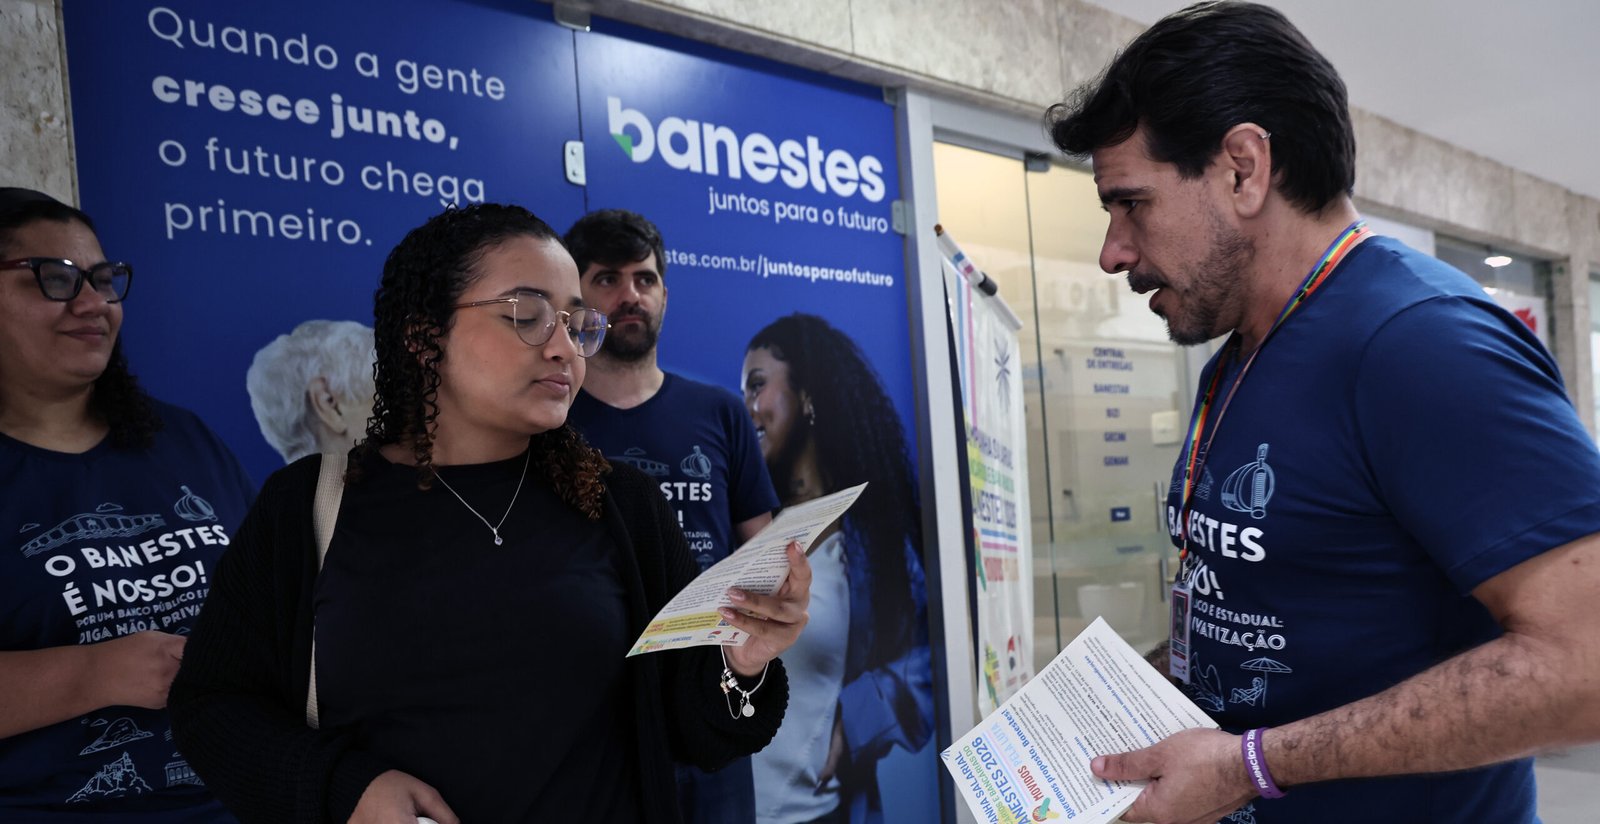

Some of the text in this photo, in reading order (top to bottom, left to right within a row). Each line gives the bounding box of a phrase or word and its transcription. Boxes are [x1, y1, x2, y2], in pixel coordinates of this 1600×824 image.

[148, 7, 505, 100] Quando a gente
[152, 75, 459, 150] cresce junto,
[159, 137, 485, 207] o futuro chega
[607, 96, 886, 202] banestes
[165, 199, 373, 245] primeiro.
[708, 186, 888, 233] juntos para o futuro
[664, 249, 894, 286] stes.com.br/juntosparaofuturo
[660, 482, 712, 502] STES
[45, 525, 230, 577] O BANESTES
[62, 561, 207, 616] É NOSSO!
[97, 611, 115, 622] UM
[117, 606, 151, 618] BANCO
[153, 591, 195, 613] PÚBLICO
[116, 619, 147, 635] NÃO
[962, 744, 973, 756] DO
[1000, 708, 1030, 747] Banestes!
[954, 751, 985, 798] SALARIAL
[968, 756, 997, 796] BANCÁRIAS
[970, 735, 1031, 824] ANESTES 2026
[989, 720, 1044, 801] MOVIDOS PELA LUTA
[1025, 744, 1055, 783] proposta,
[1246, 740, 1268, 788] FEMINICÍDIO
[1049, 781, 1076, 819] Queremos
